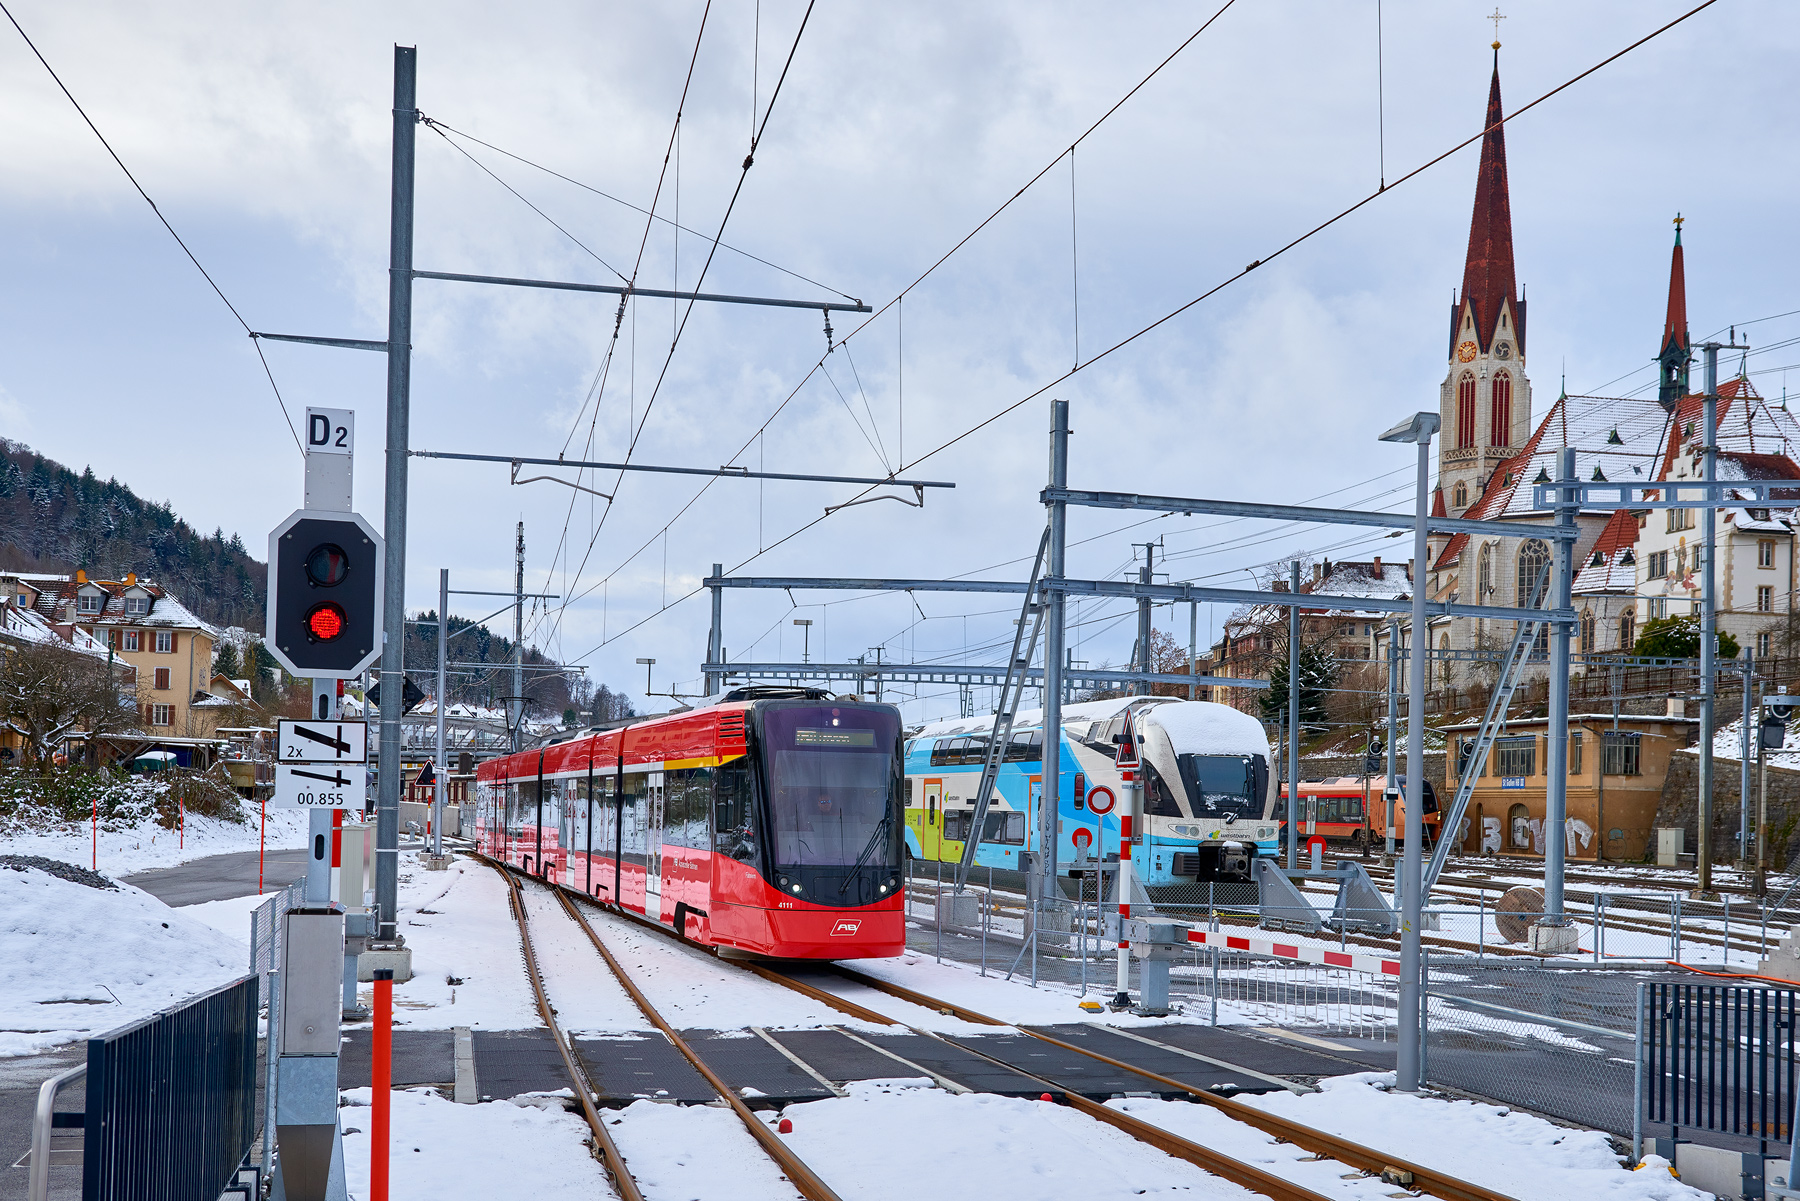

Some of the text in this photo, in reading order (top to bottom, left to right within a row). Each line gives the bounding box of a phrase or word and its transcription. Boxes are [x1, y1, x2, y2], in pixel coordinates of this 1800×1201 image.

[287, 745, 303, 758] 2x
[297, 792, 344, 806] 00.855
[836, 923, 858, 931] AB
